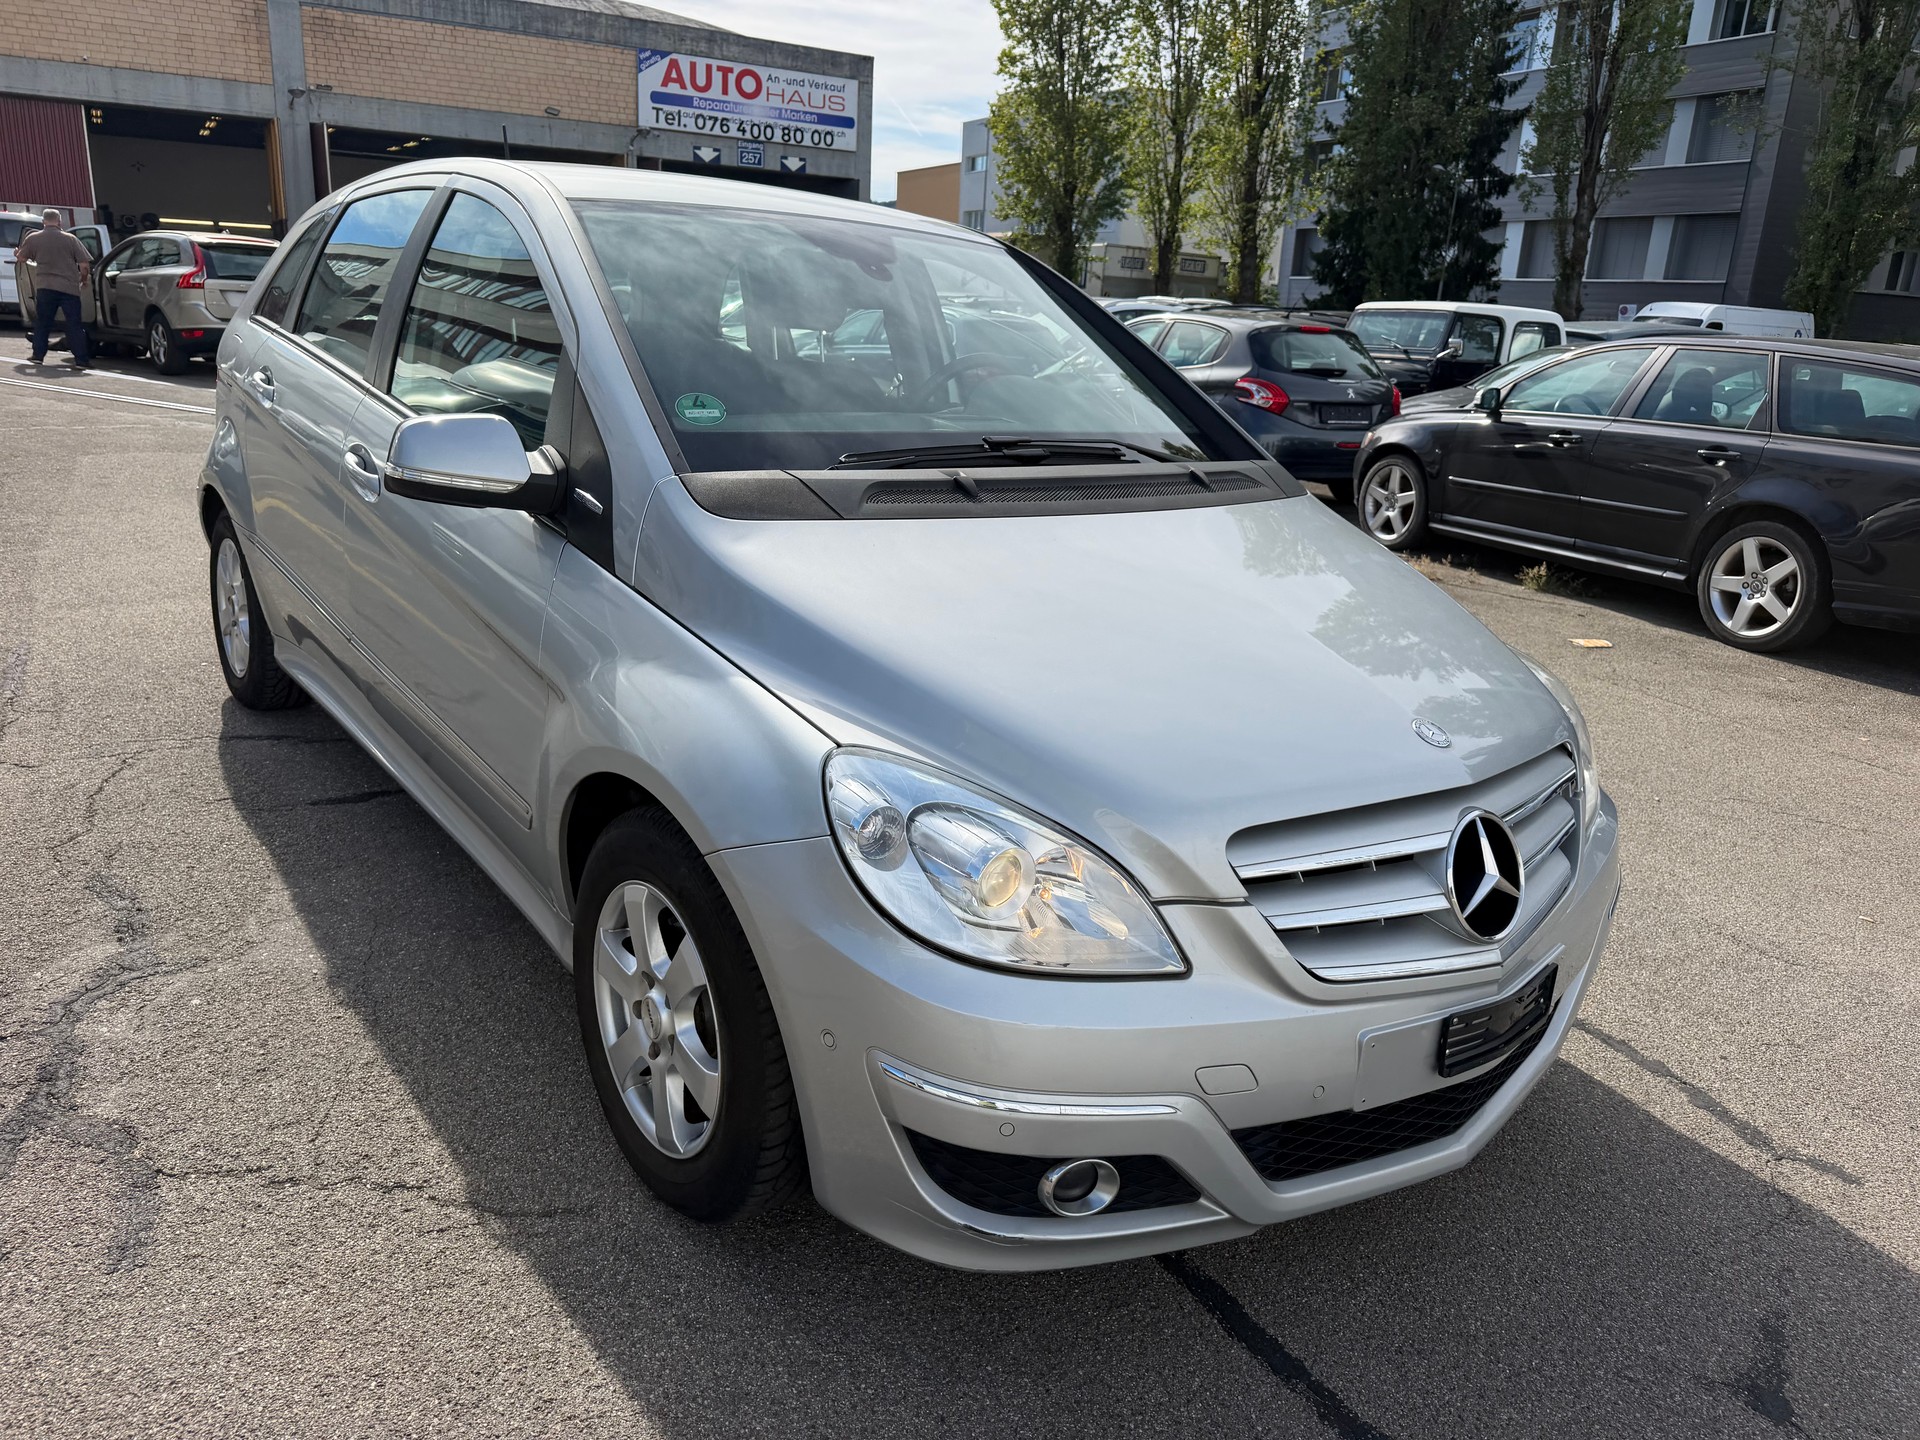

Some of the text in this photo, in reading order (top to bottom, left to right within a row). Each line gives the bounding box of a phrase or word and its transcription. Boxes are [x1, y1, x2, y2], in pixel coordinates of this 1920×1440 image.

[660, 58, 846, 112] AUTO HAUS
[766, 74, 846, 93] An -und Verkauf
[782, 109, 818, 123] Marken
[652, 106, 834, 147] Tel. 076 400 80 00
[738, 140, 764, 151] Eingang
[741, 152, 761, 164] 257
[692, 395, 707, 409] 4
